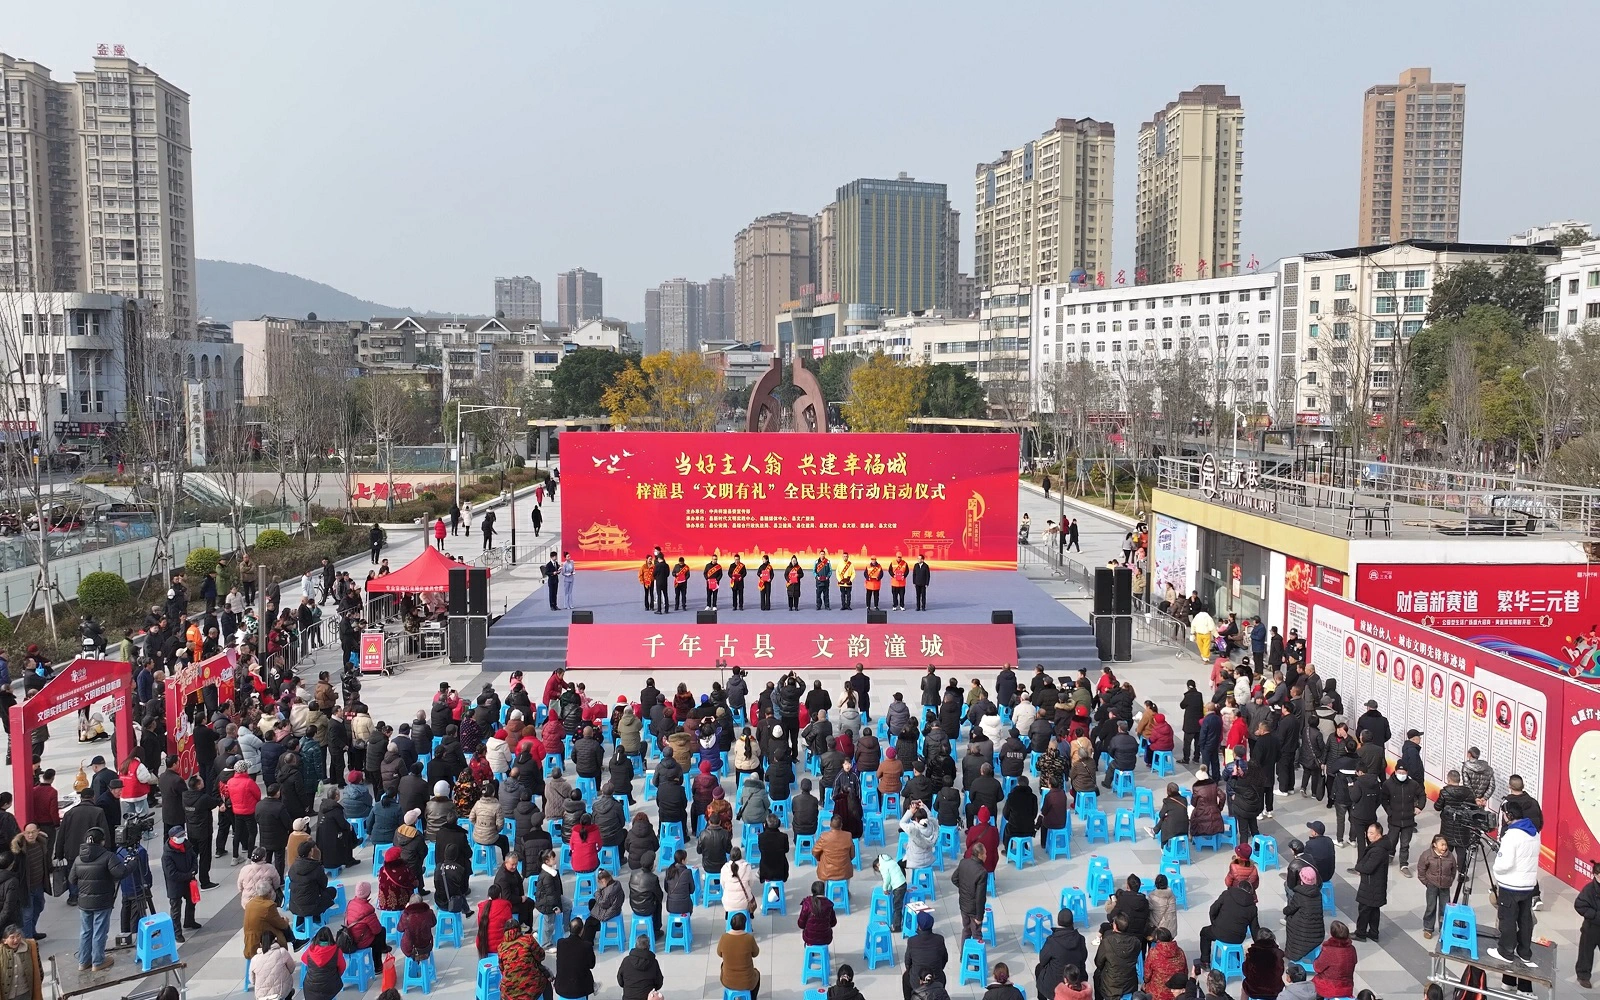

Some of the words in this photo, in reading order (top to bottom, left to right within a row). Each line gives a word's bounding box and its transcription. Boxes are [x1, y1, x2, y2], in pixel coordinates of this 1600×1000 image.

[674, 451, 784, 477] 当好主人翁
[797, 451, 908, 476] 共建幸福城
[636, 482, 947, 502] 梓潼县“文明有礼”全民共建行动启动仪式
[1219, 490, 1252, 509] SANYUAN
[1254, 498, 1276, 514] LANE
[1396, 590, 1479, 613] 财富新赛道
[1497, 589, 1580, 613] 繁华三元巷
[642, 632, 776, 660] 千年古县
[812, 632, 945, 660] 文韵潼城
